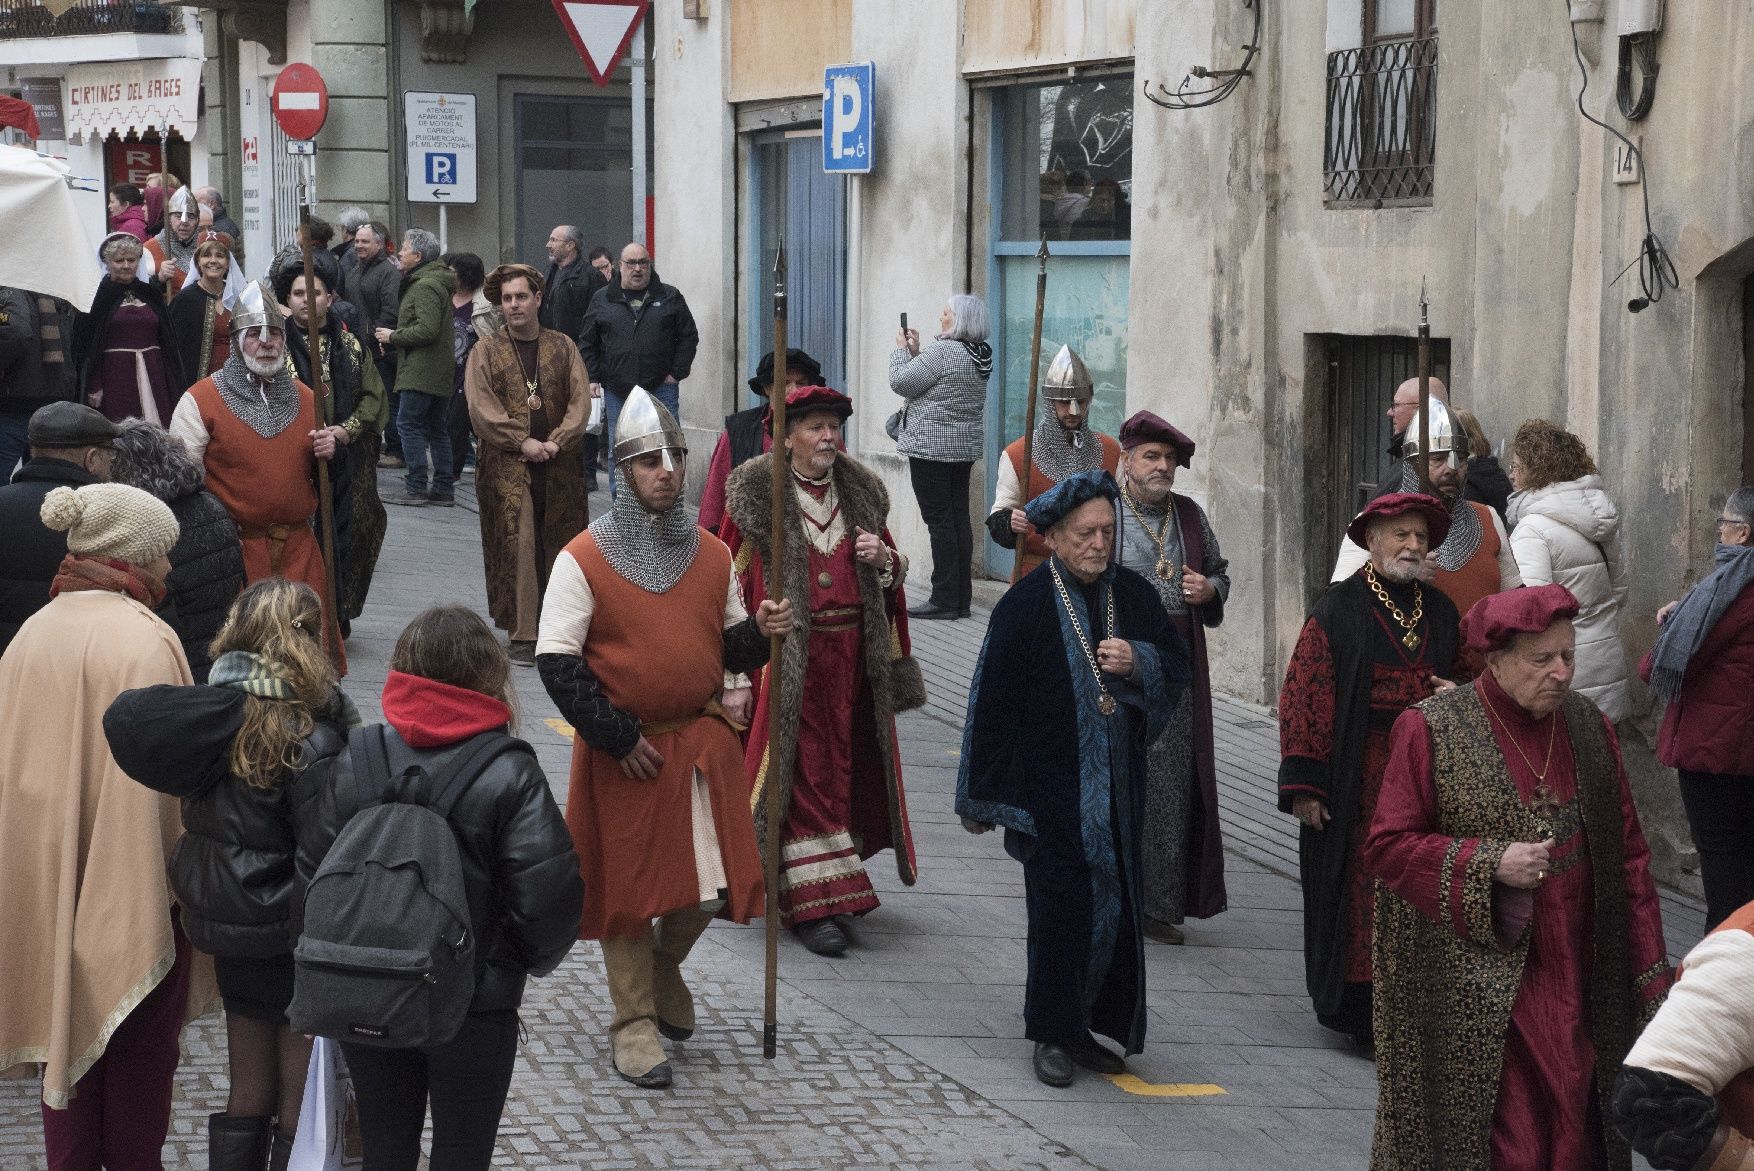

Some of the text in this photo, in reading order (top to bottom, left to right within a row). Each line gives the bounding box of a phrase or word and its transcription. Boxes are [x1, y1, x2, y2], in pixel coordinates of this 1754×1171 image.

[127, 83, 142, 100] DEL
[147, 78, 181, 98] BAGES
[832, 77, 861, 159] P
[432, 156, 451, 183] P
[1617, 145, 1633, 174] 14
